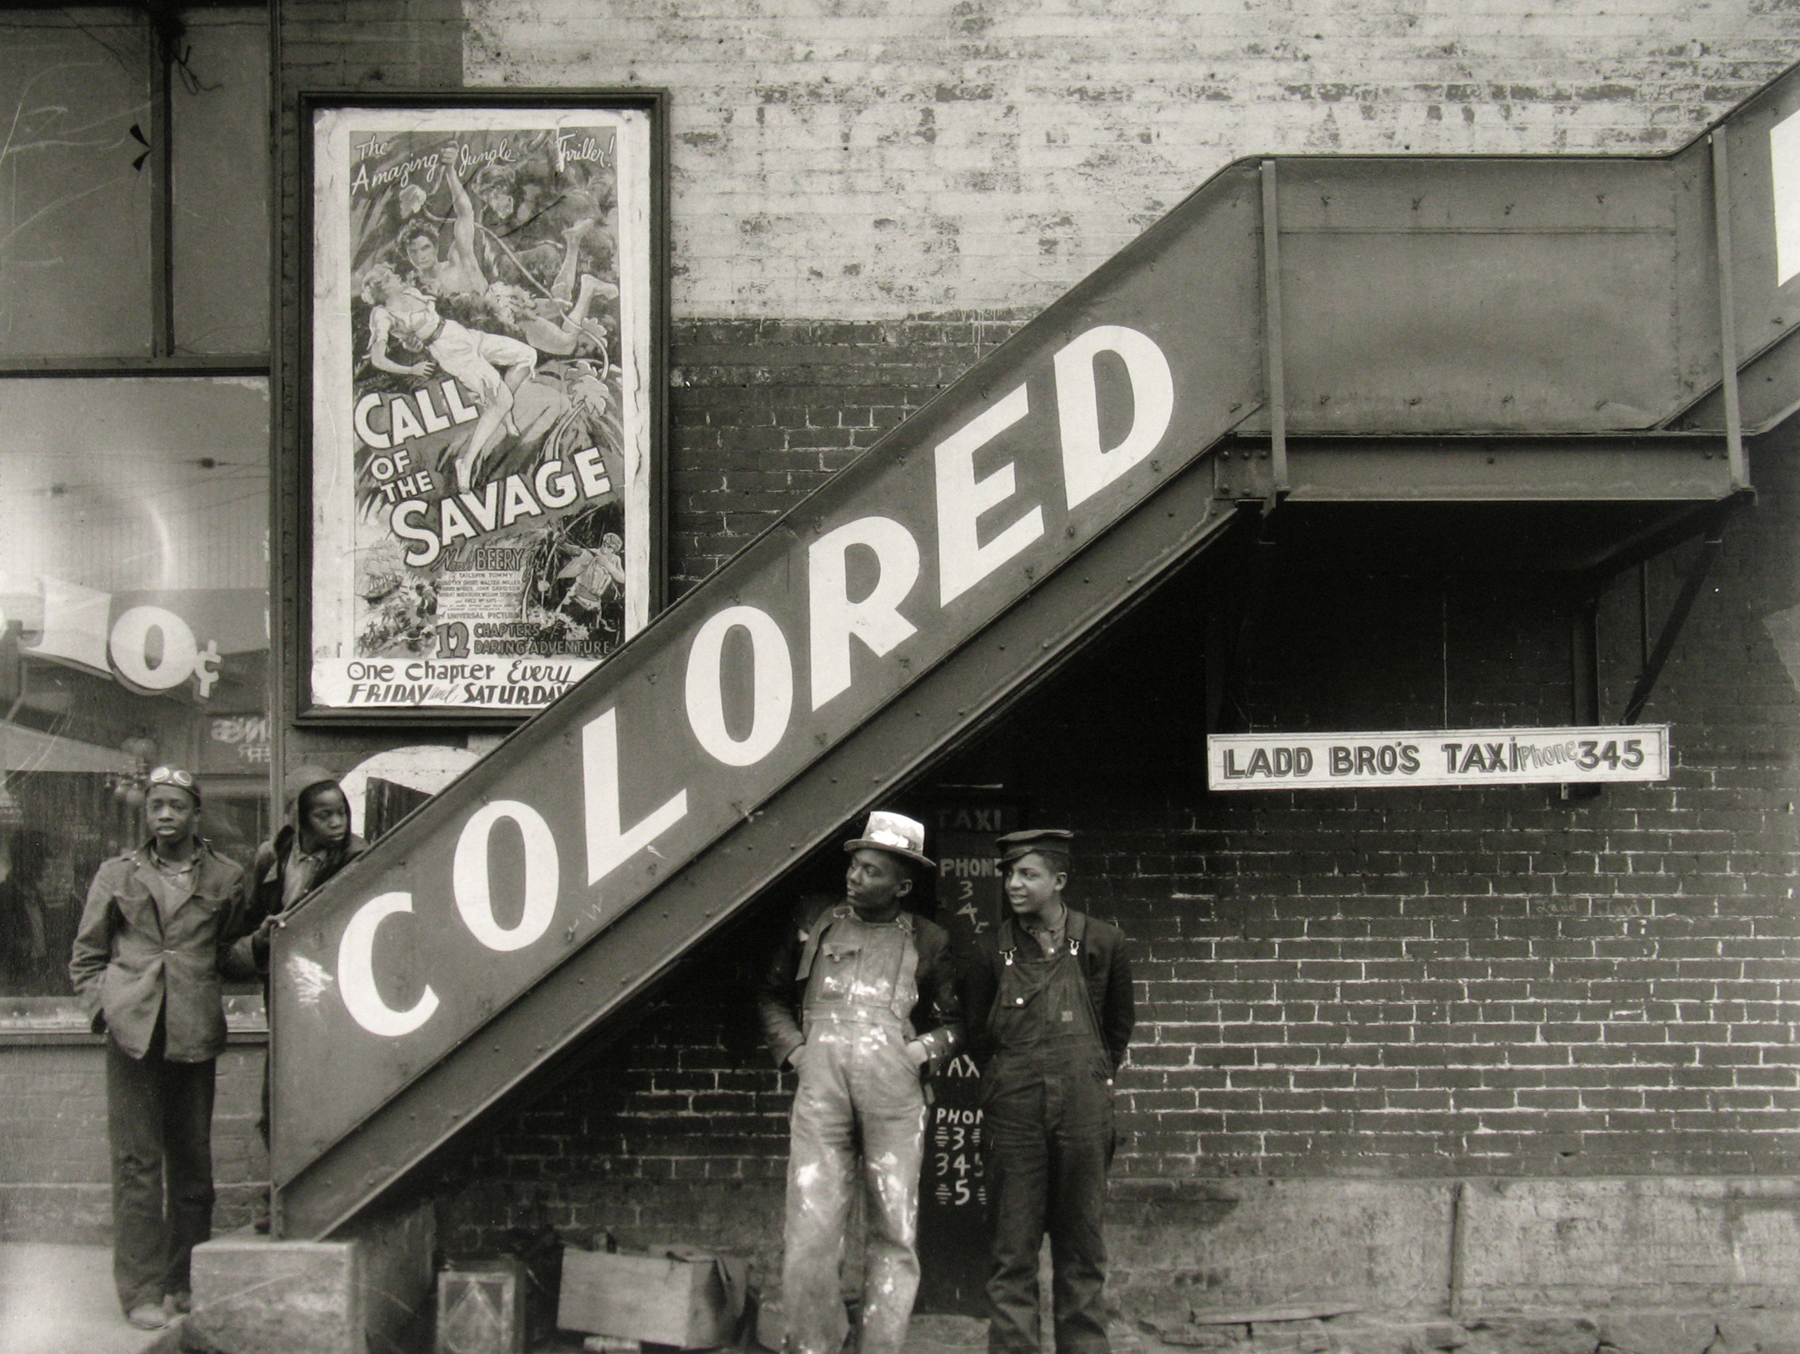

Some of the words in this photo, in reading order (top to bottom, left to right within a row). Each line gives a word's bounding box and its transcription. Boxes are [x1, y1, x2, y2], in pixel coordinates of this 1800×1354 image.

[355, 133, 389, 162] The
[351, 153, 440, 196] Amazing
[457, 138, 517, 177] Jungle
[556, 132, 615, 172] Thriller!
[354, 379, 480, 449] CALL
[370, 450, 411, 480] OF
[380, 470, 434, 503] THE
[390, 447, 612, 568] SAVAGE
[475, 547, 526, 571] BEERY
[435, 621, 471, 660] 12
[473, 622, 542, 639] CHAPTERS
[473, 640, 526, 656] DARING
[527, 640, 611, 656] ADVENTURE
[337, 325, 1175, 1037] COLORED
[347, 662, 395, 682] One
[507, 659, 577, 685] Every
[347, 684, 434, 706] FRIDAY
[1223, 746, 1314, 780] LADD
[1329, 740, 1421, 777] BRO'S
[1518, 740, 1578, 772] Phone
[1575, 739, 1645, 771] 345
[958, 880, 974, 901] 3
[955, 902, 979, 926] 4
[951, 1126, 966, 1151] 3
[954, 1178, 971, 1206] 5
